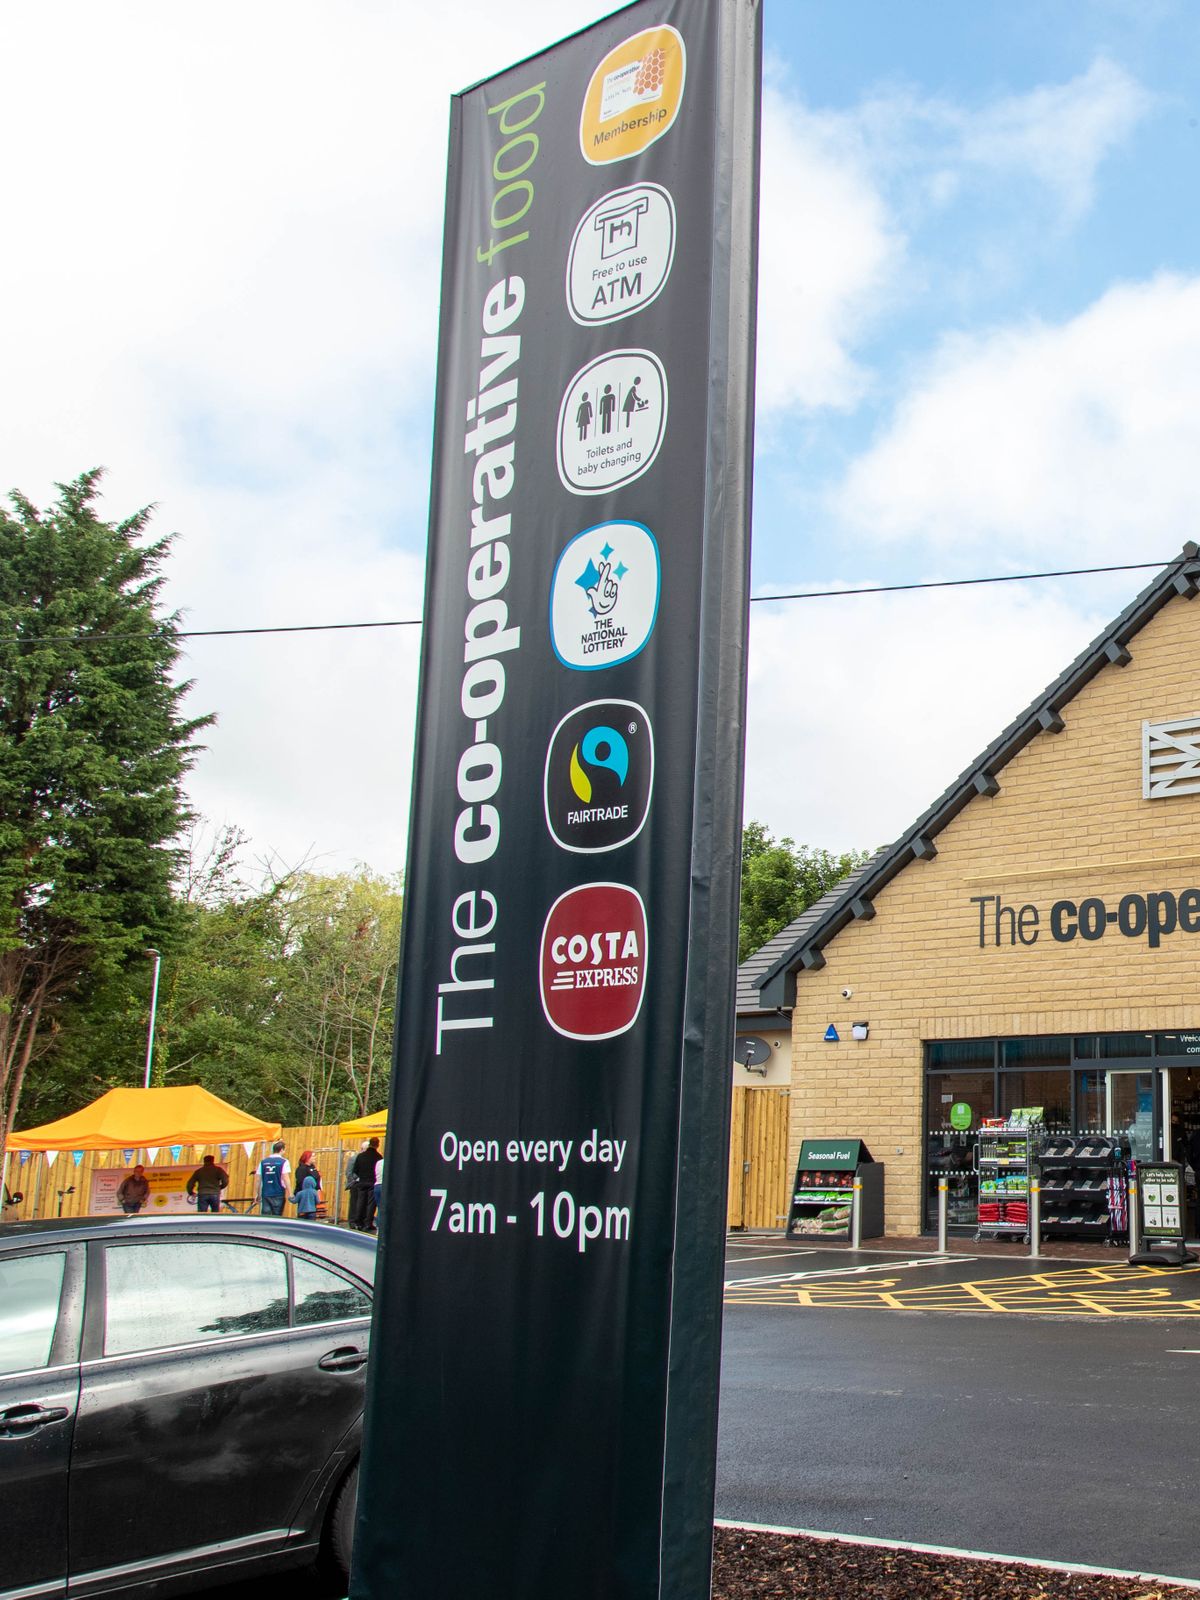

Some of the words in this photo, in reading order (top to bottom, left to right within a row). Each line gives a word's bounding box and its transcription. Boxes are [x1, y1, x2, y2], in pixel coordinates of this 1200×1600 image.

[593, 108, 667, 147] Membership
[476, 80, 547, 266] food
[592, 267, 613, 281] Free
[615, 261, 625, 272] to
[628, 255, 648, 267] use
[591, 272, 642, 310] ATM
[586, 446, 614, 459] Toilets
[616, 437, 633, 452] and
[577, 462, 599, 476] baby
[600, 452, 641, 469] changing
[454, 275, 526, 864] co-operative
[581, 627, 628, 644] NATIONAL
[594, 618, 613, 630] THE
[583, 638, 625, 654] LOTTERY
[567, 805, 629, 825] FAIRTRADE
[970, 895, 1040, 948] The
[551, 930, 639, 965] COSTA
[436, 889, 499, 1055] The
[575, 966, 638, 989] EXPRESS
[439, 1131, 500, 1170] Open
[505, 1137, 574, 1172] every
[580, 1128, 627, 1172] day
[808, 1151, 836, 1160] Seasonal
[836, 1151, 851, 1160] Fuel
[430, 1188, 496, 1234] 7am
[505, 1214, 517, 1224] -
[529, 1191, 631, 1252] 10pm
